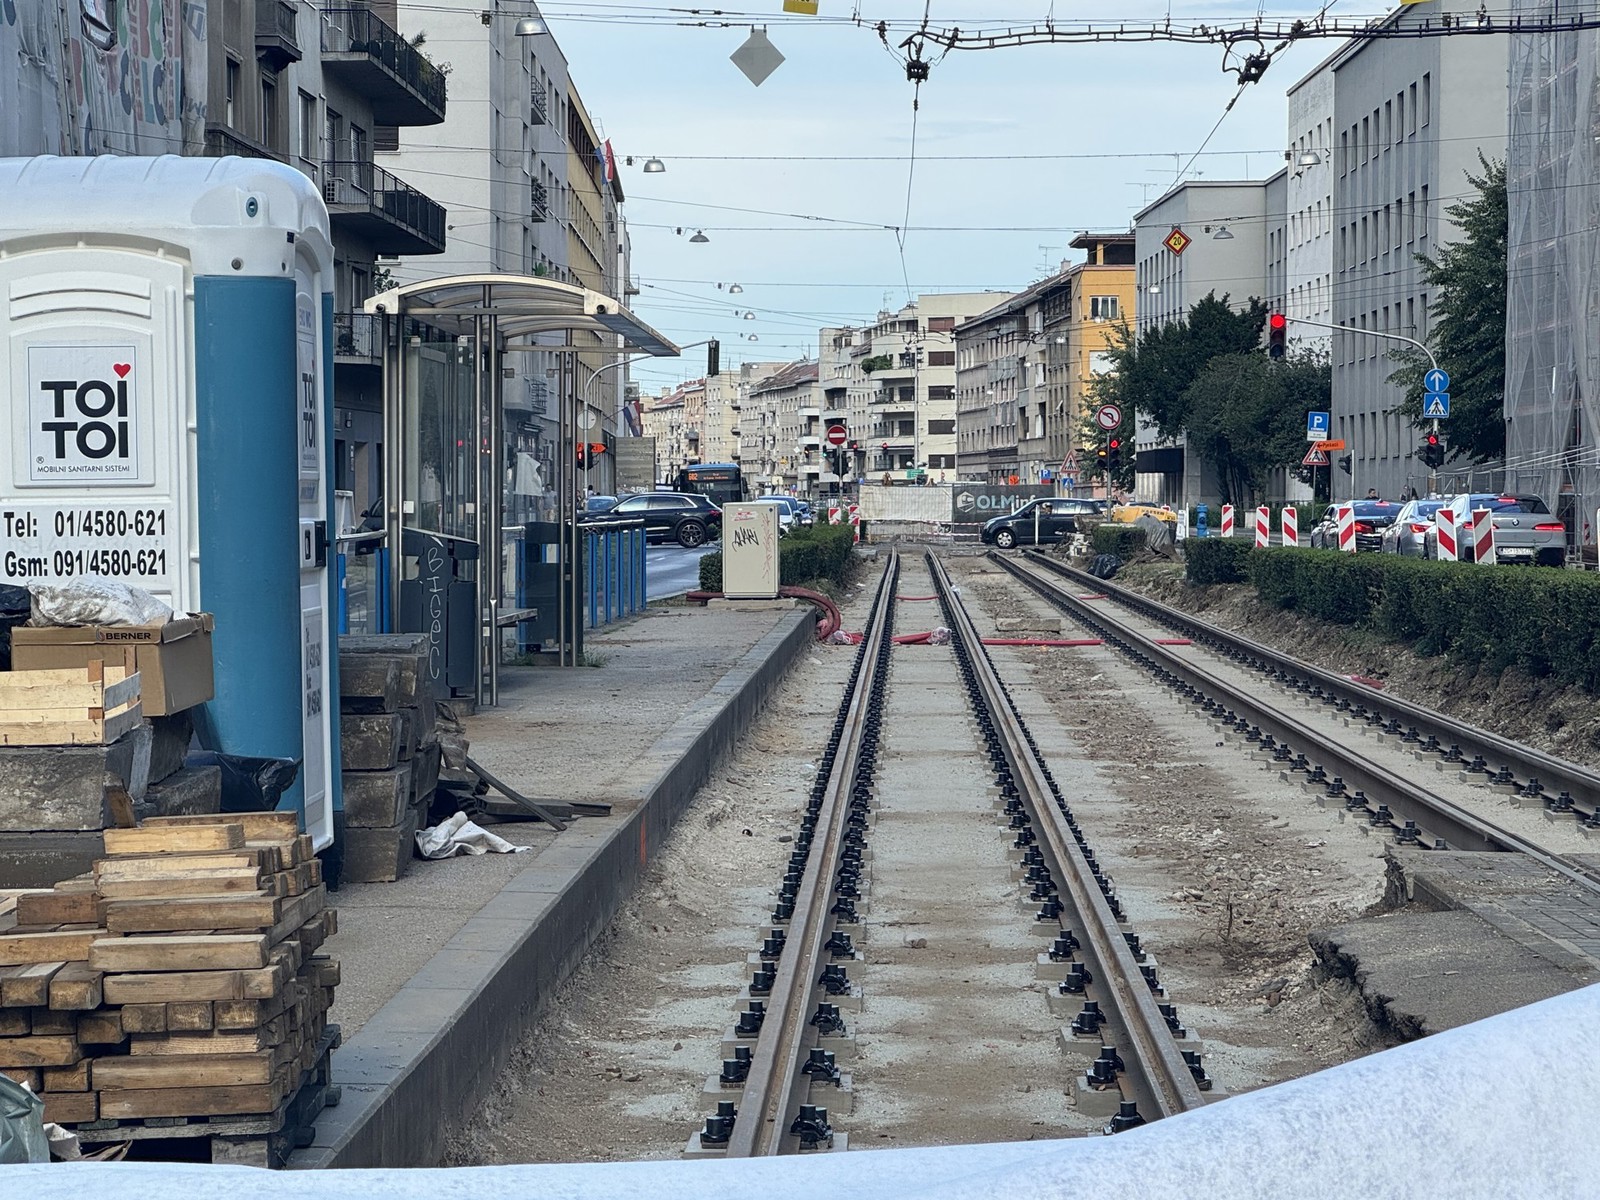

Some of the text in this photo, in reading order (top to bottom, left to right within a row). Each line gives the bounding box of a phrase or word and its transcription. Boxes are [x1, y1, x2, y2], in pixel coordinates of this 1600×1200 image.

[1173, 236, 1182, 246] 20
[41, 379, 128, 418] TOI
[1313, 415, 1323, 428] P
[41, 421, 129, 459] TOI
[37, 465, 67, 473] MOBILNI
[68, 465, 103, 473] SANITARNI
[3, 509, 166, 537] Tel: 01/4580-621
[5, 549, 166, 577] Gsm: 091/4580-621
[105, 632, 152, 640] BERNER
